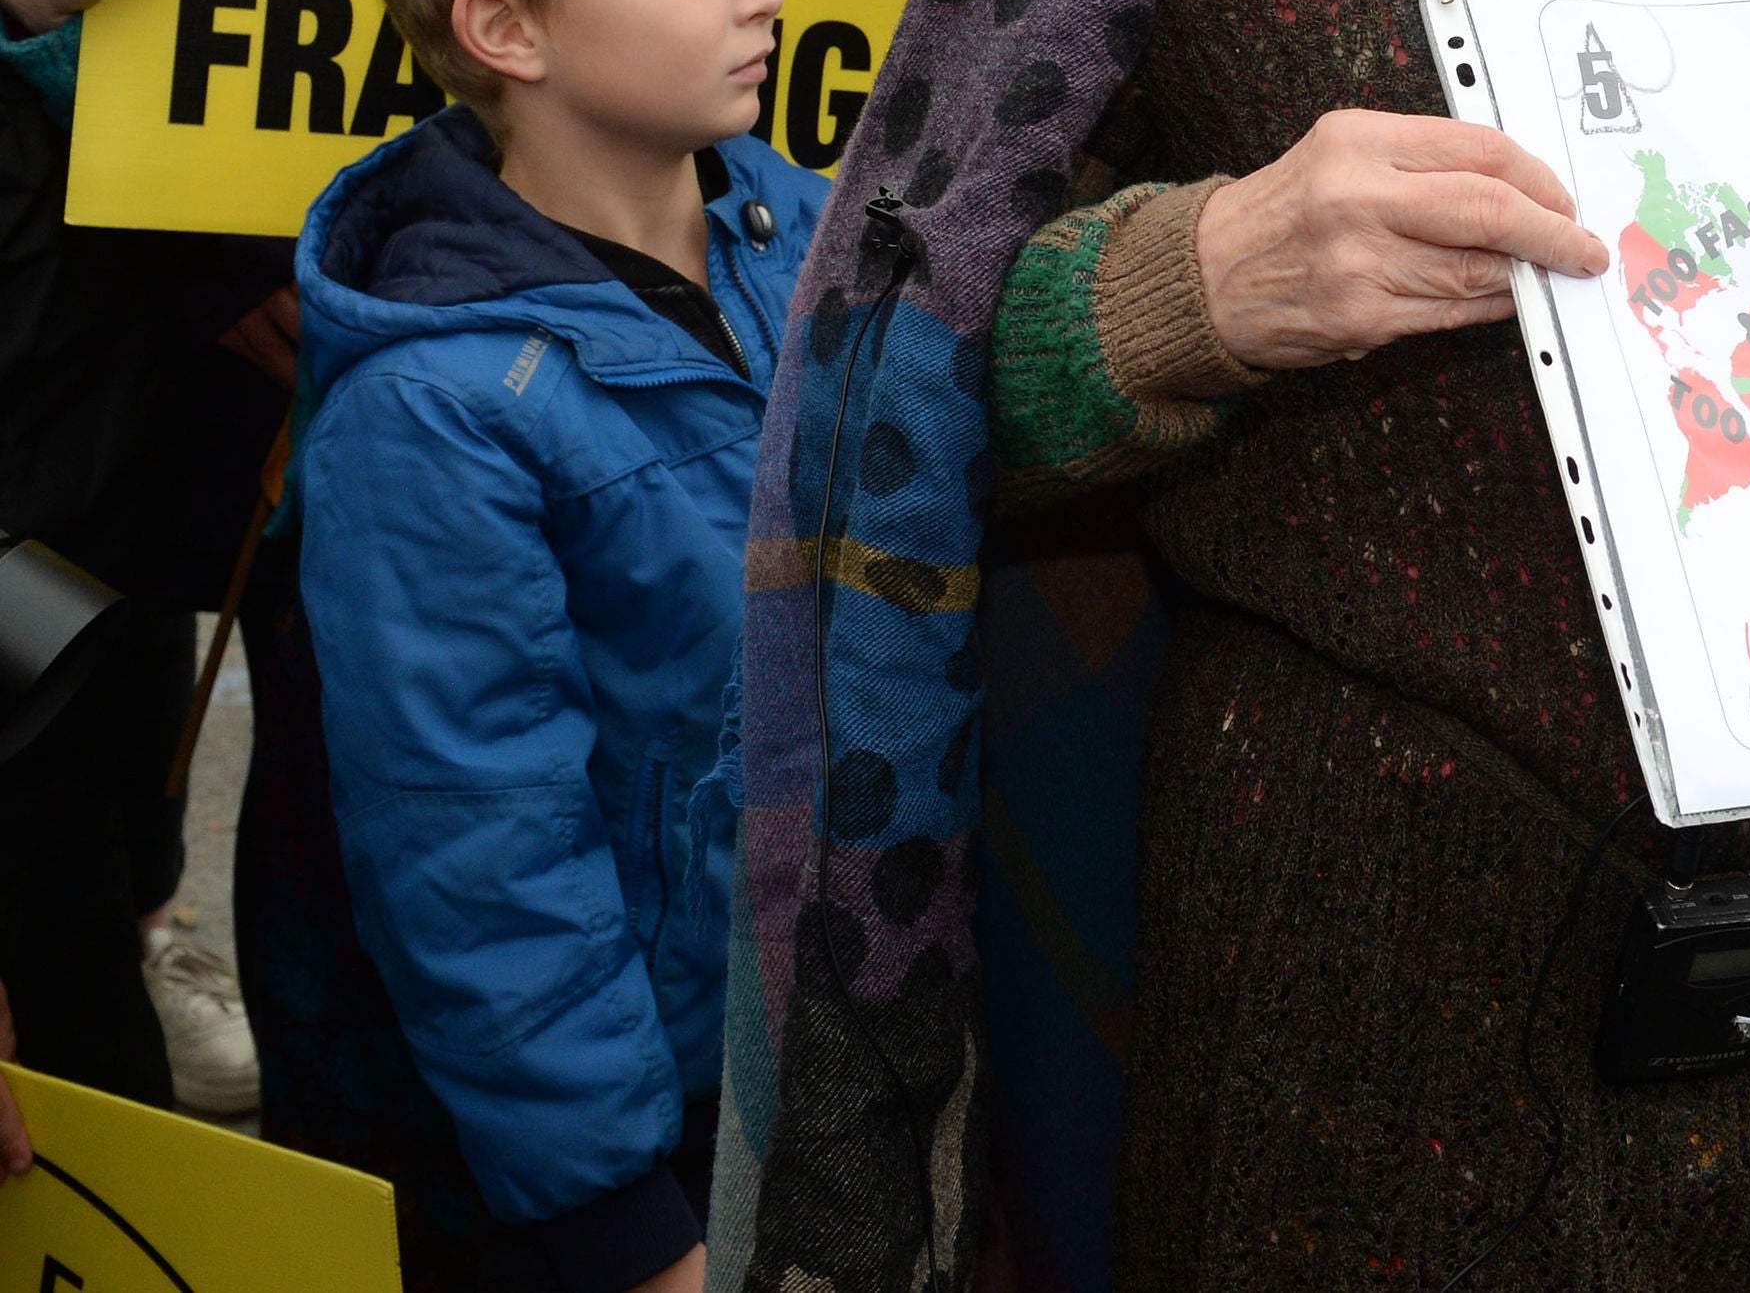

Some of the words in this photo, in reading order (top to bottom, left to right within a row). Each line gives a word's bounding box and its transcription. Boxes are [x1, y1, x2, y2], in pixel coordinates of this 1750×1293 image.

[1577, 51, 1623, 120] 5
[1632, 248, 1698, 317] TOO
[1670, 374, 1747, 445] TOO
